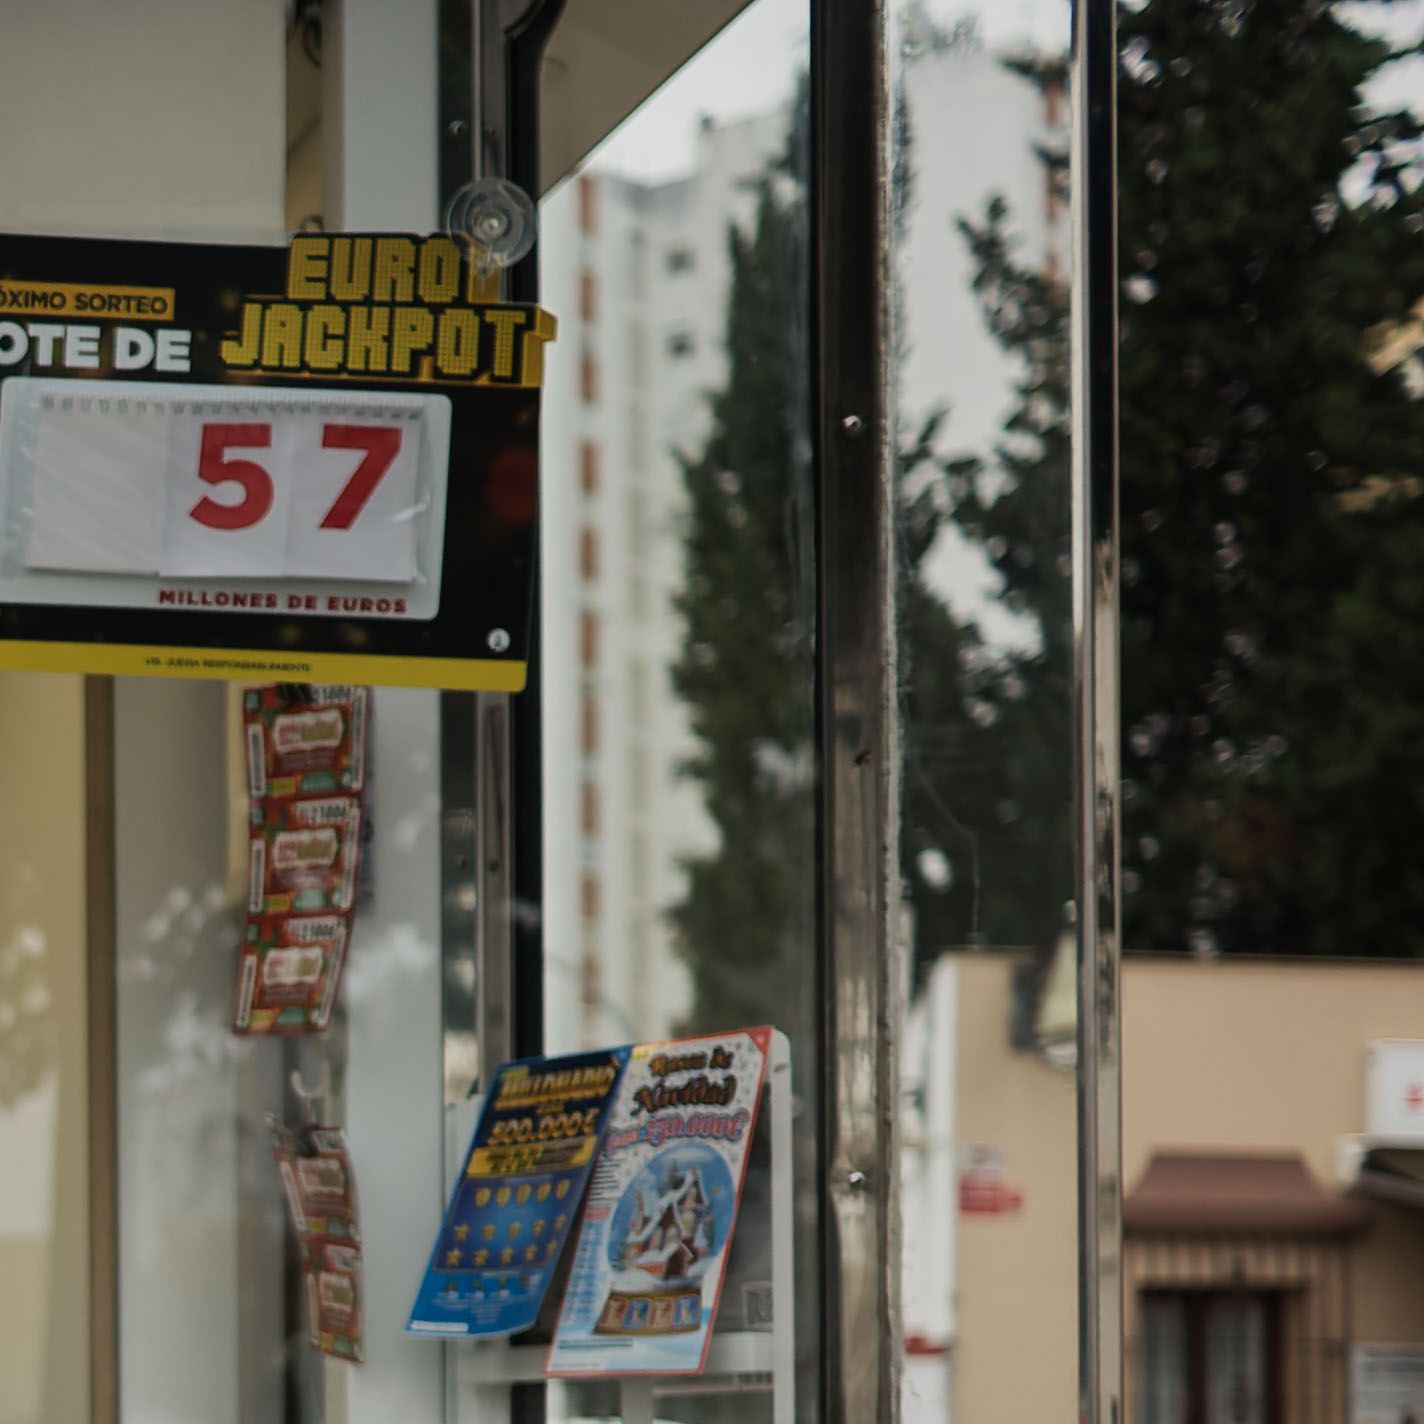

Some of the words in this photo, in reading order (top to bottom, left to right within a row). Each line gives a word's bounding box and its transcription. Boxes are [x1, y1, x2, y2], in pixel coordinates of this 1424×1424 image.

[287, 236, 461, 303] EURO
[74, 291, 169, 314] SORTEO
[112, 325, 193, 373] DE
[219, 302, 528, 378] JACKPOT
[158, 589, 279, 609] MILLONES
[287, 593, 319, 611] DE
[327, 596, 408, 614] EUROS
